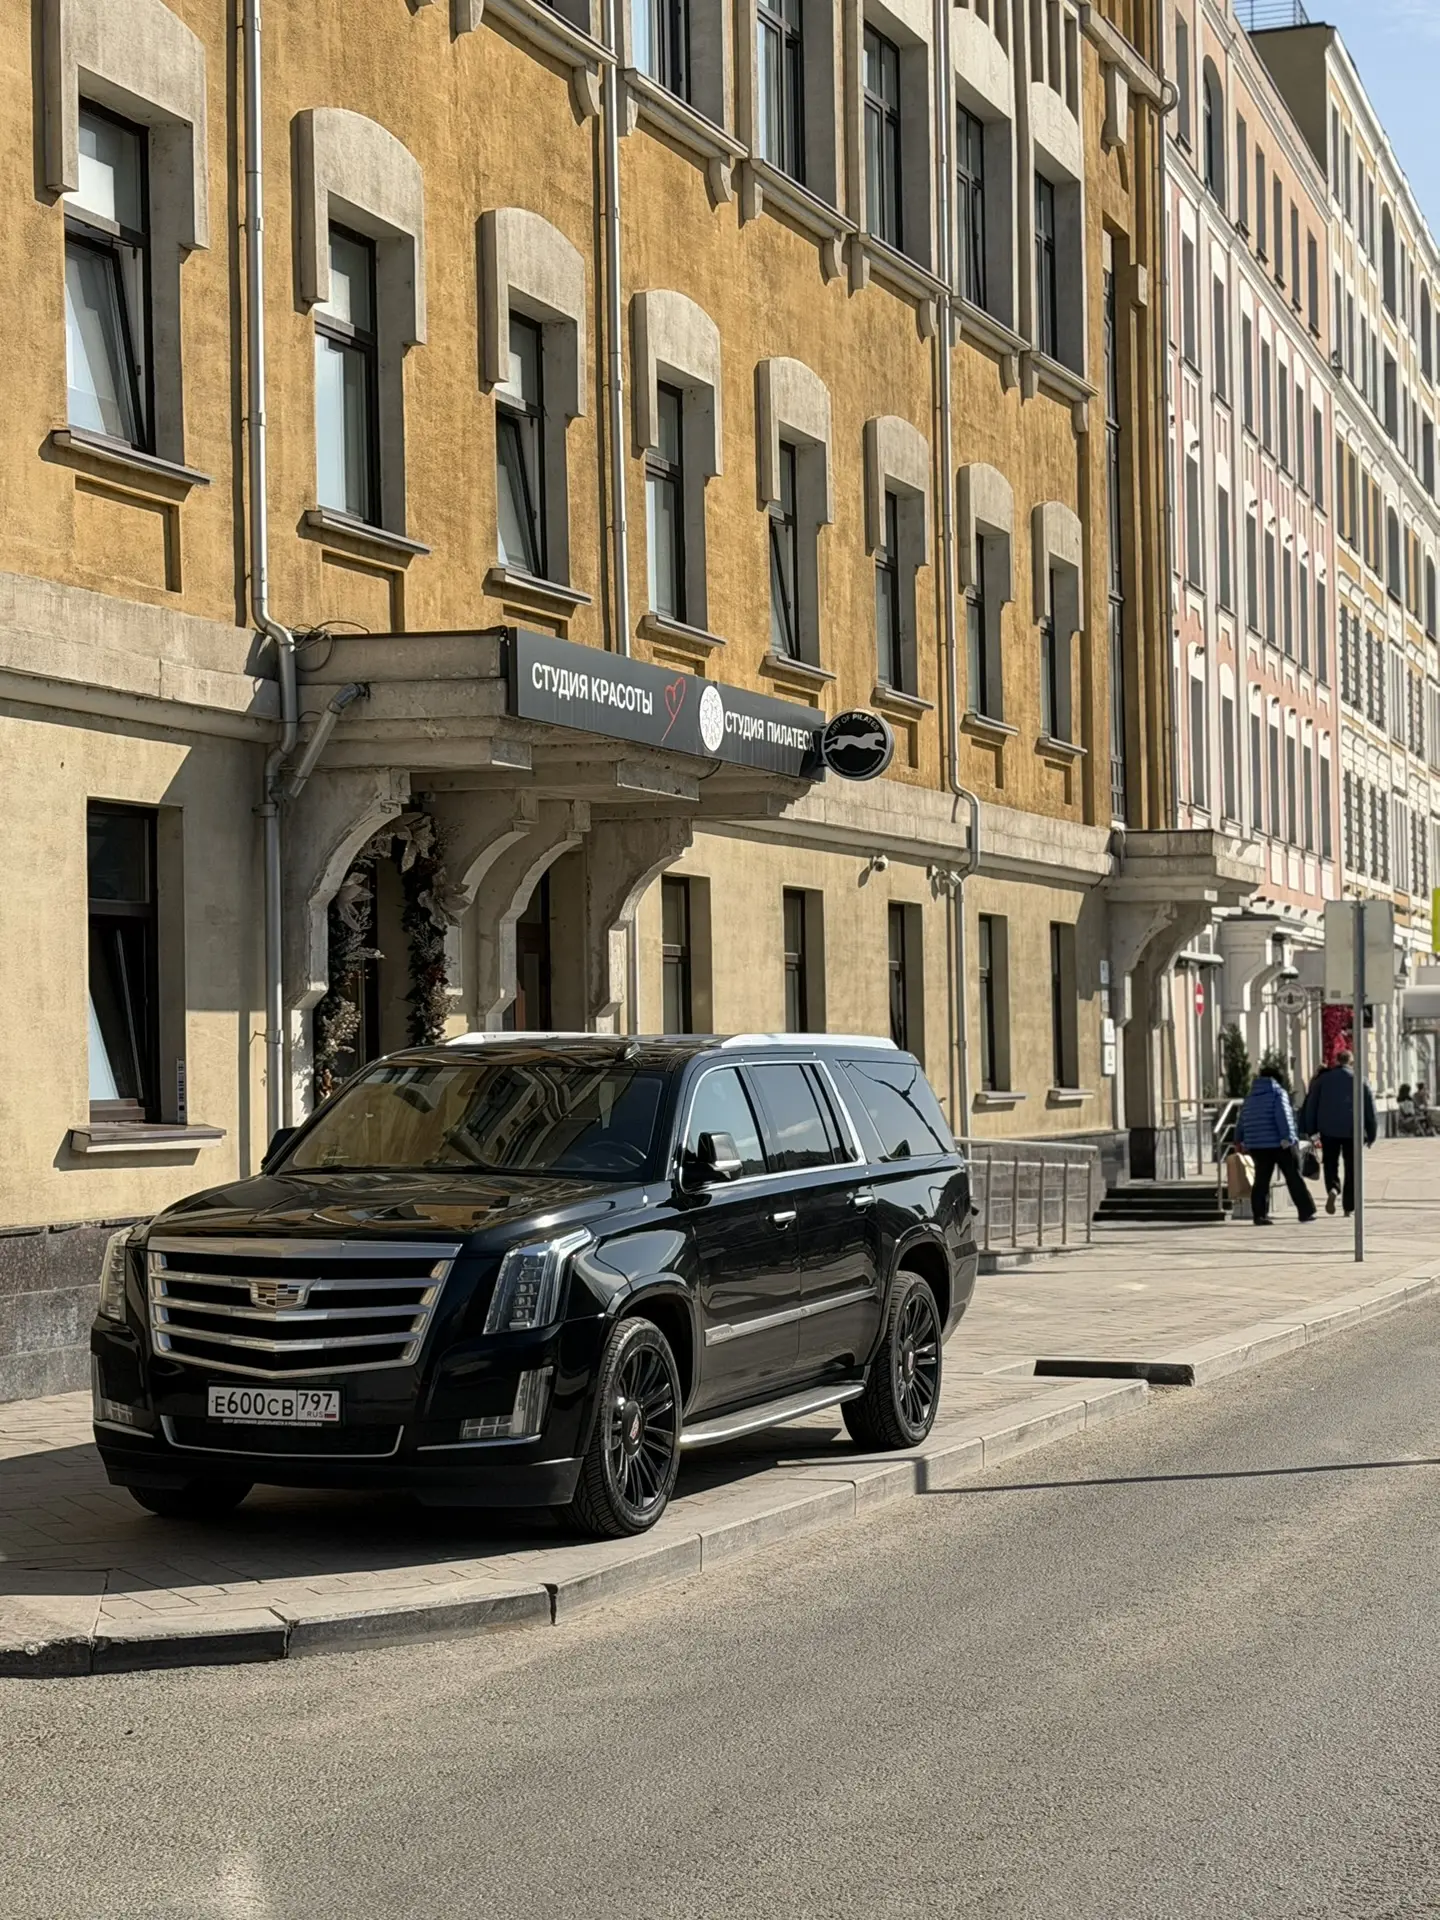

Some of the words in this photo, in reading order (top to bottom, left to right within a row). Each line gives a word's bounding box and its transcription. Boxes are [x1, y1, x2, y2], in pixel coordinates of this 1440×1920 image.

[532, 662, 588, 701] СТУДИЯ
[591, 677, 653, 715] КРАСОТЫ
[725, 711, 764, 741] СТУДИЯ
[829, 719, 841, 735] ART
[840, 716, 850, 724] OF
[852, 713, 880, 731] PILATES
[298, 1393, 333, 1411] 797
[306, 1410, 324, 1418] RUS
